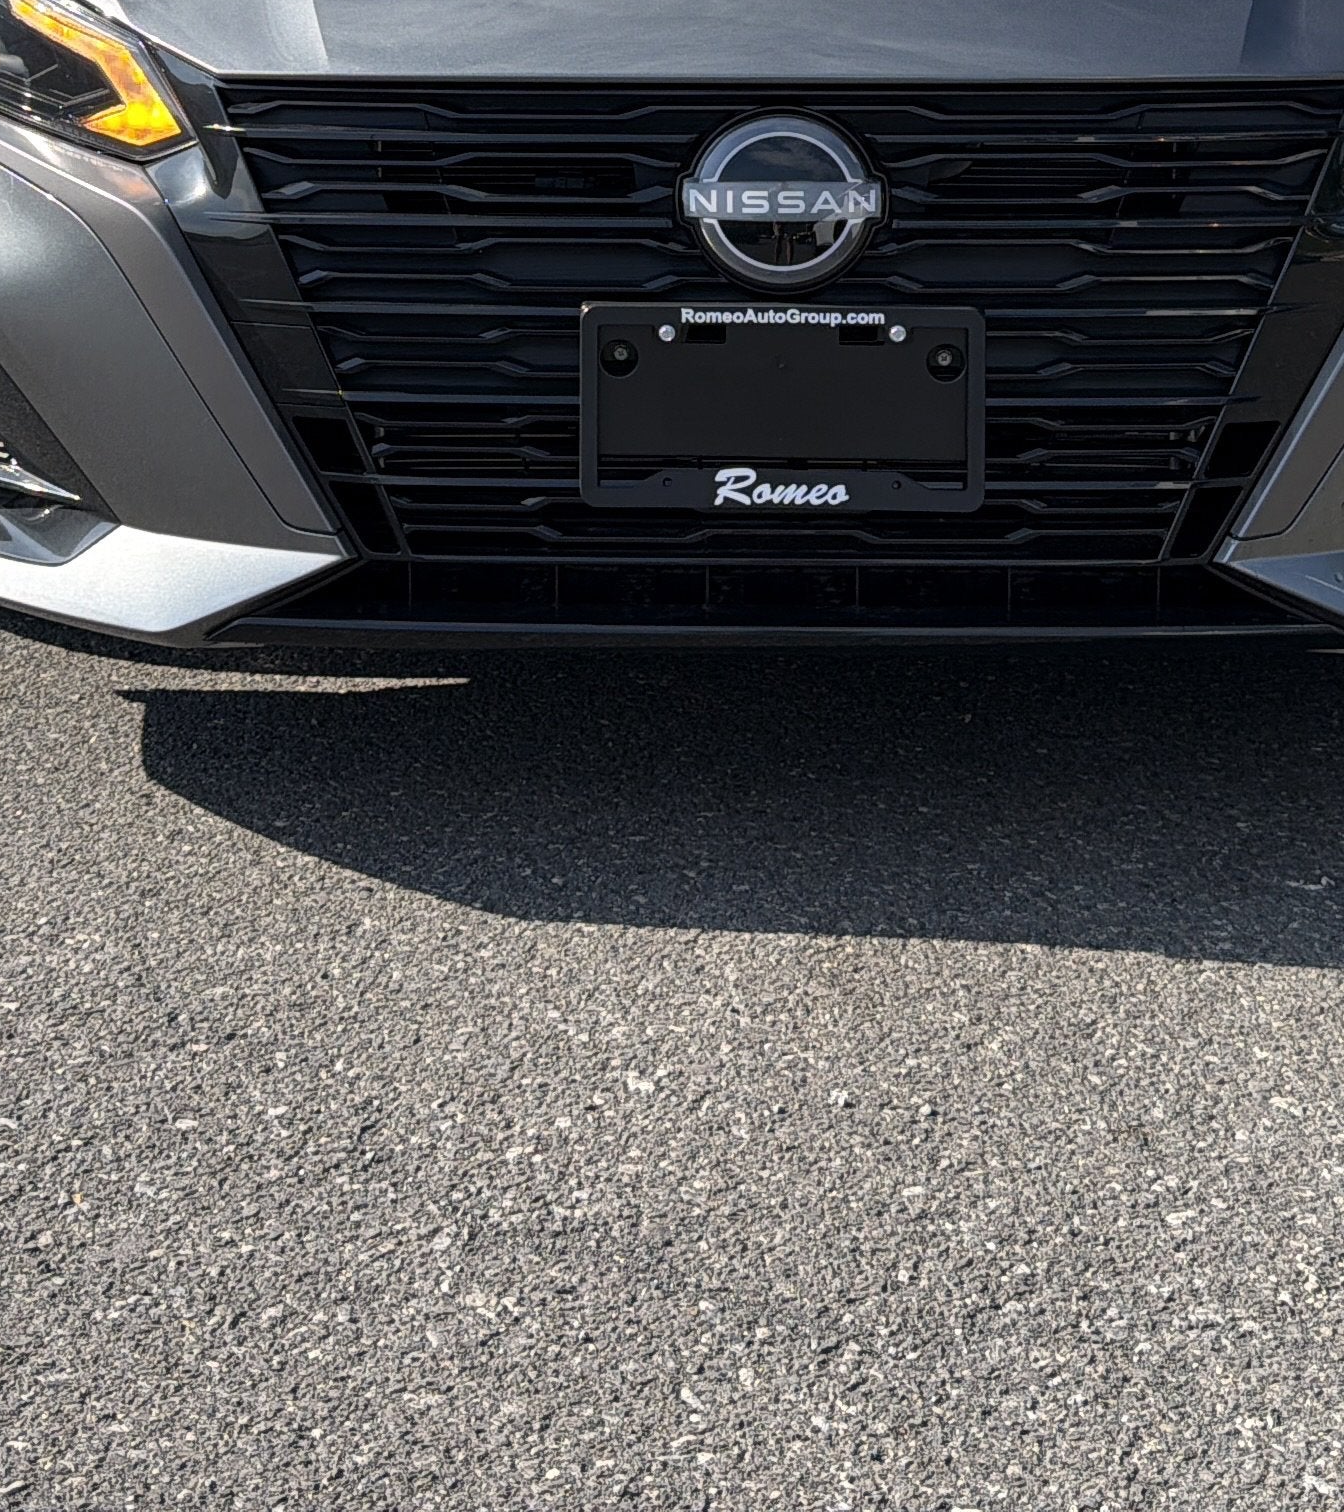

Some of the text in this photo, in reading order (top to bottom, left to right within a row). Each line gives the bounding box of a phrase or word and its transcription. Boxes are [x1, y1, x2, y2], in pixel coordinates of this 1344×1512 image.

[689, 189, 876, 214] NISSAN
[681, 308, 885, 327] RomeoAutoGroup.com
[714, 467, 850, 506] Romeo
